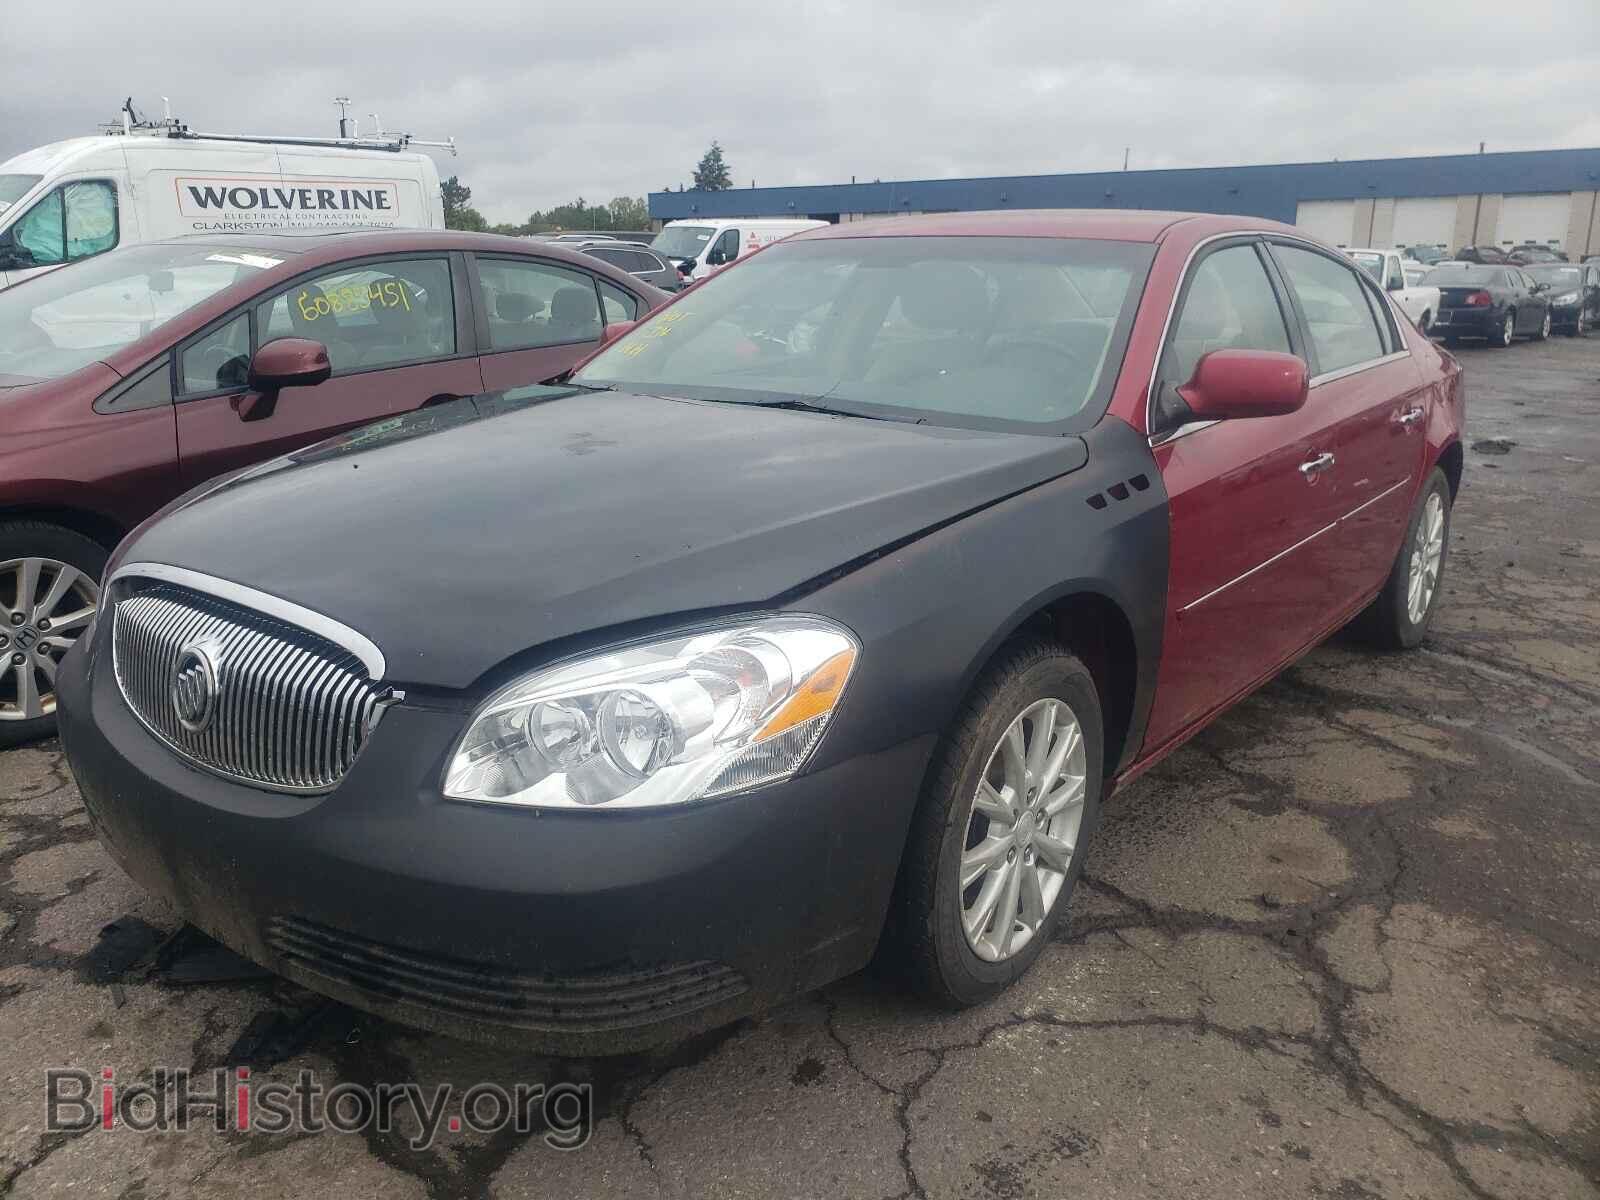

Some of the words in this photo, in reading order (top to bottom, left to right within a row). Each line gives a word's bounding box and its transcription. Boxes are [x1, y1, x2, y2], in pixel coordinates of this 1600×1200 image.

[188, 186, 391, 209] WOLVERINE
[224, 212, 290, 220] ELECTRICAL
[295, 213, 368, 221] CONTRACTING
